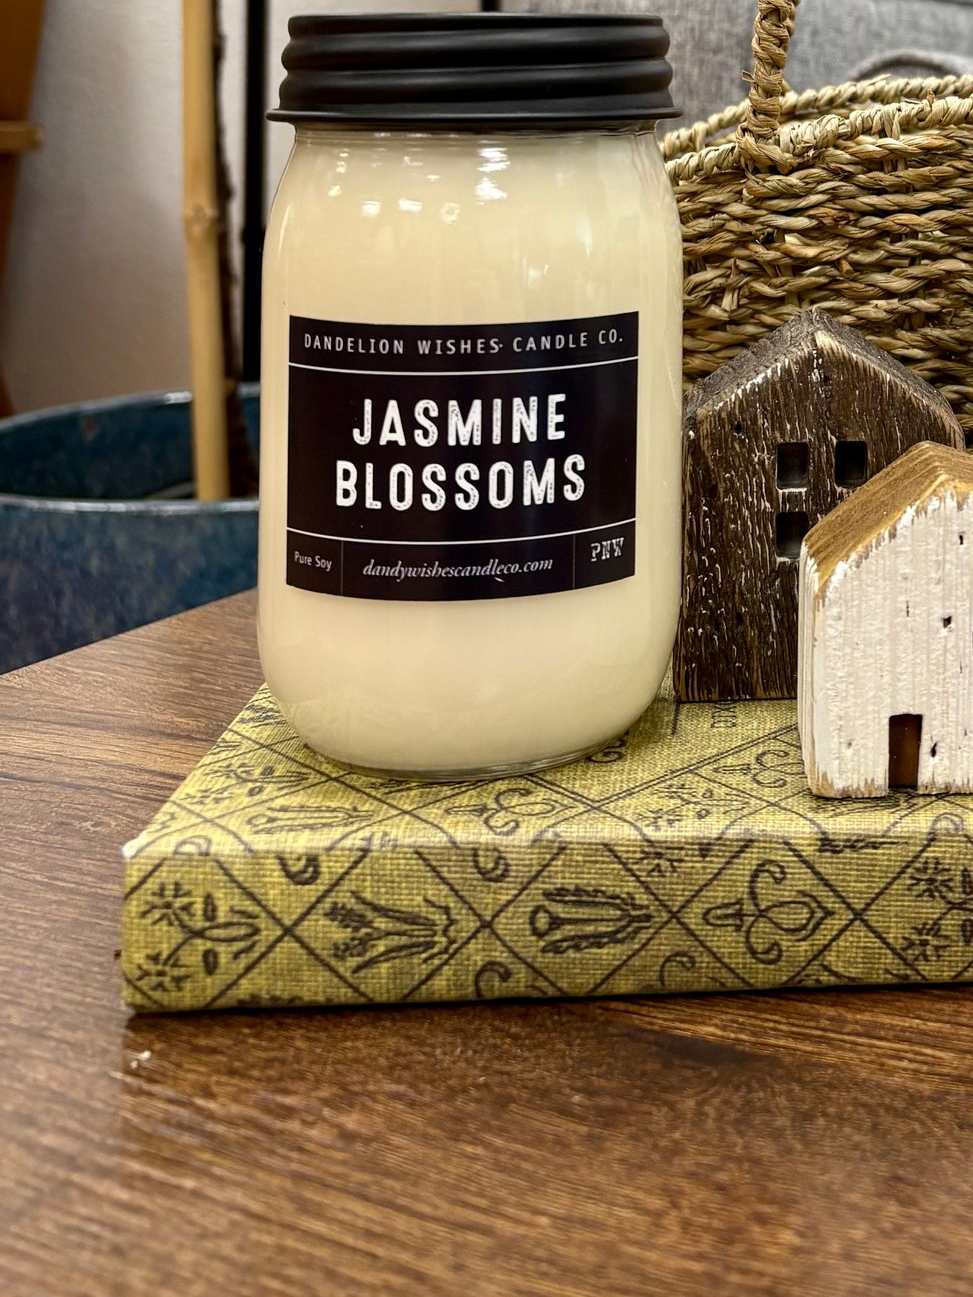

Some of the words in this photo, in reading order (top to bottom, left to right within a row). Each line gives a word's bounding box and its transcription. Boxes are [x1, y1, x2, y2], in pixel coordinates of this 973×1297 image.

[304, 333, 404, 355] DANDELION
[417, 339, 500, 355] WISHES
[512, 332, 588, 352] CANDLE
[598, 328, 623, 345] CO.
[352, 393, 566, 448] JASMINE
[335, 453, 586, 512] BLOSSOMS
[294, 550, 313, 566] Pure
[315, 555, 332, 572] Soy
[590, 537, 625, 562] PNW
[362, 558, 553, 583] dandywishescandleco.com
